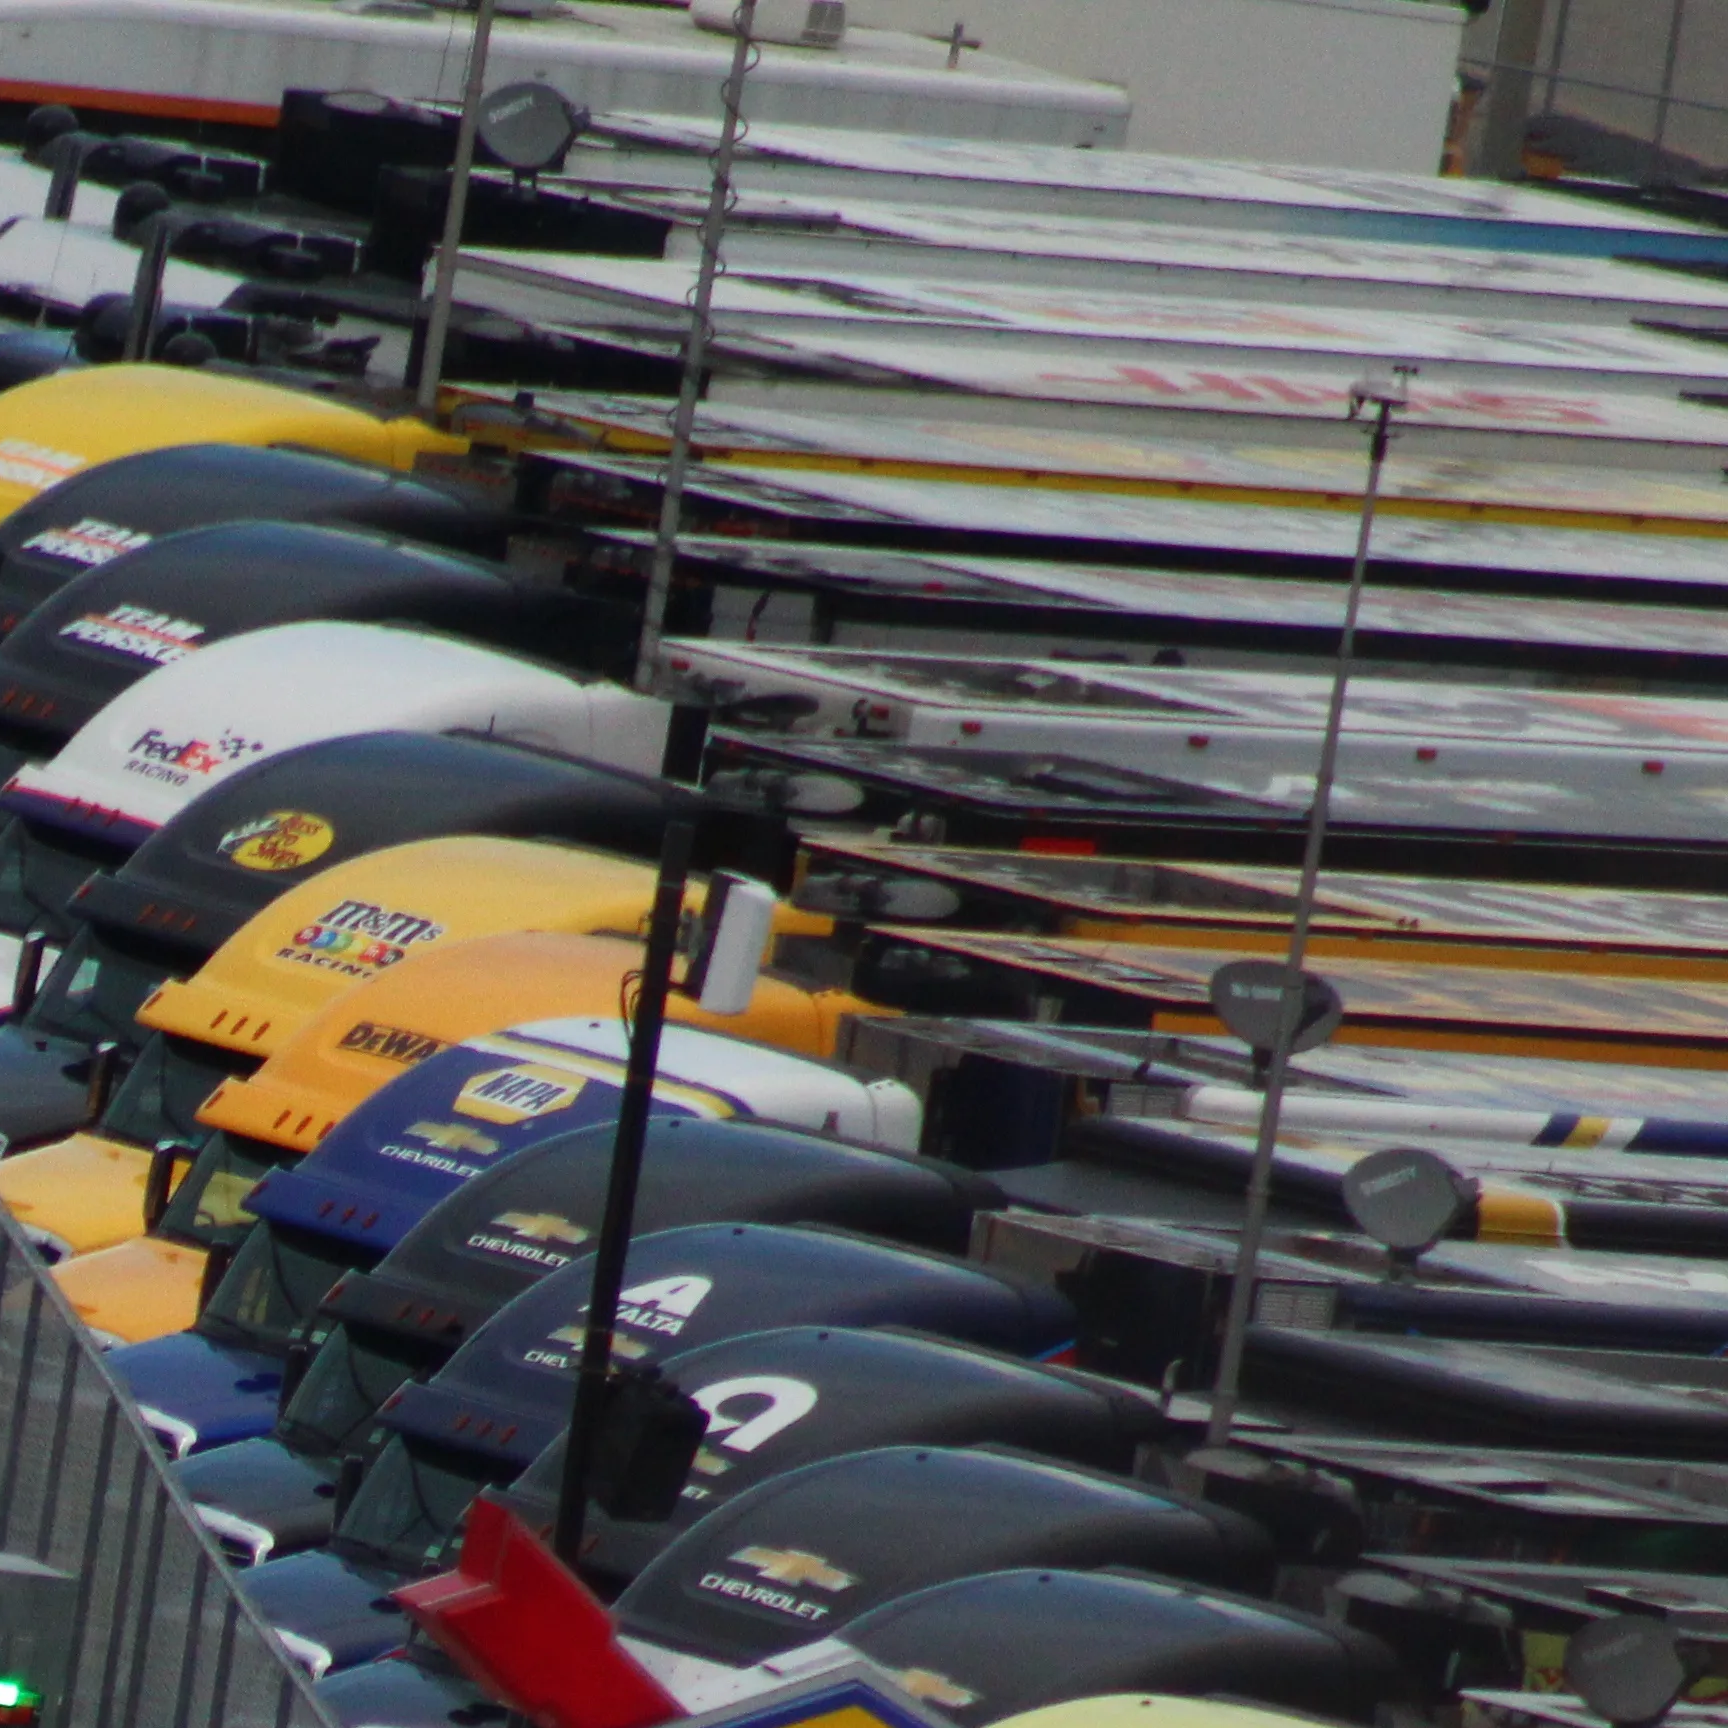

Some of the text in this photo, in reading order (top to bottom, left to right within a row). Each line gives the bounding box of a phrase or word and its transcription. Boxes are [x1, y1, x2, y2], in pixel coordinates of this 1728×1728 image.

[106, 604, 206, 641] TEAM
[128, 729, 223, 774] FedEx
[123, 760, 189, 787] RACING
[471, 1072, 567, 1110] NAPA
[378, 1145, 483, 1178] CHEVROLET
[467, 1234, 572, 1269] CHEVROLET
[698, 1573, 829, 1621] CHEVROLET
